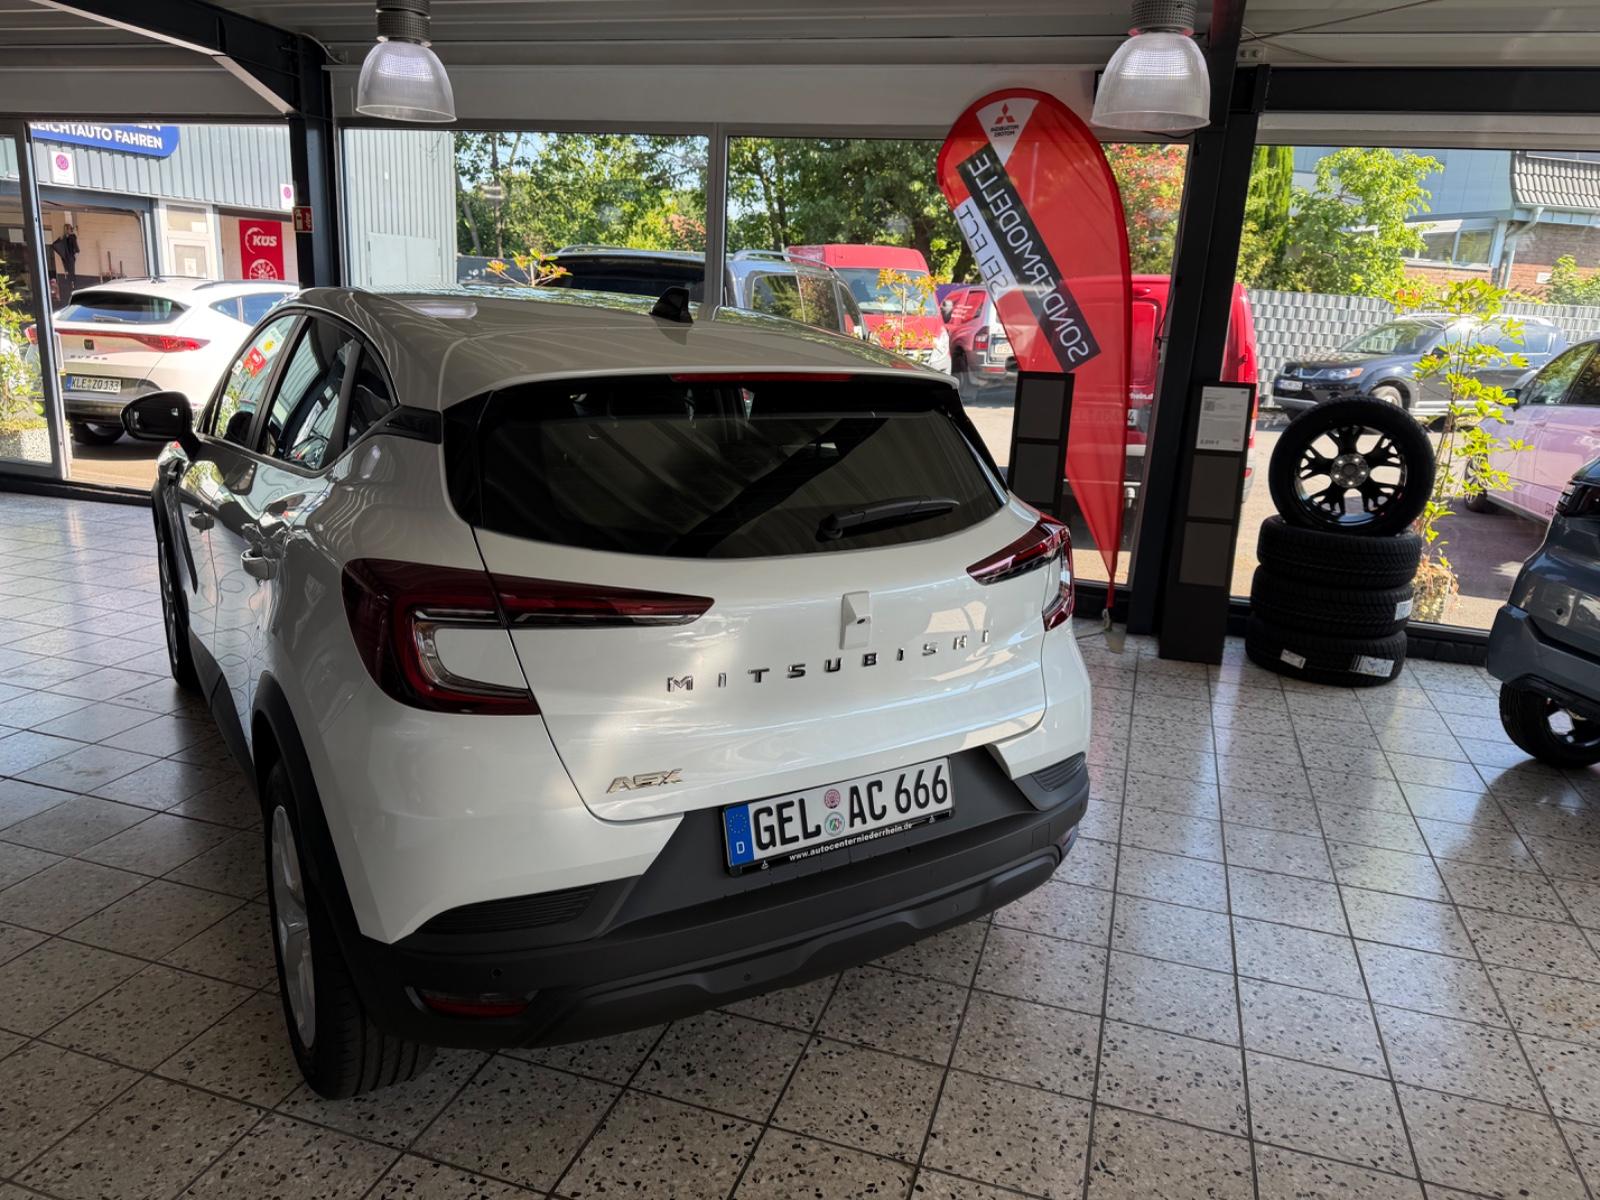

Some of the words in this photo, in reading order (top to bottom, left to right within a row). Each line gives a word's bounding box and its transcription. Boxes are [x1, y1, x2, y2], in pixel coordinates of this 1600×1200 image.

[114, 129, 163, 149] FAHREN
[666, 630, 990, 692] MITSUBISHI
[606, 767, 682, 793] ASX
[753, 798, 822, 851] GEL
[849, 780, 887, 828] AC
[894, 764, 948, 814] 666
[736, 841, 745, 855] D
[789, 821, 913, 862] www.autocenterniederrhein.de
